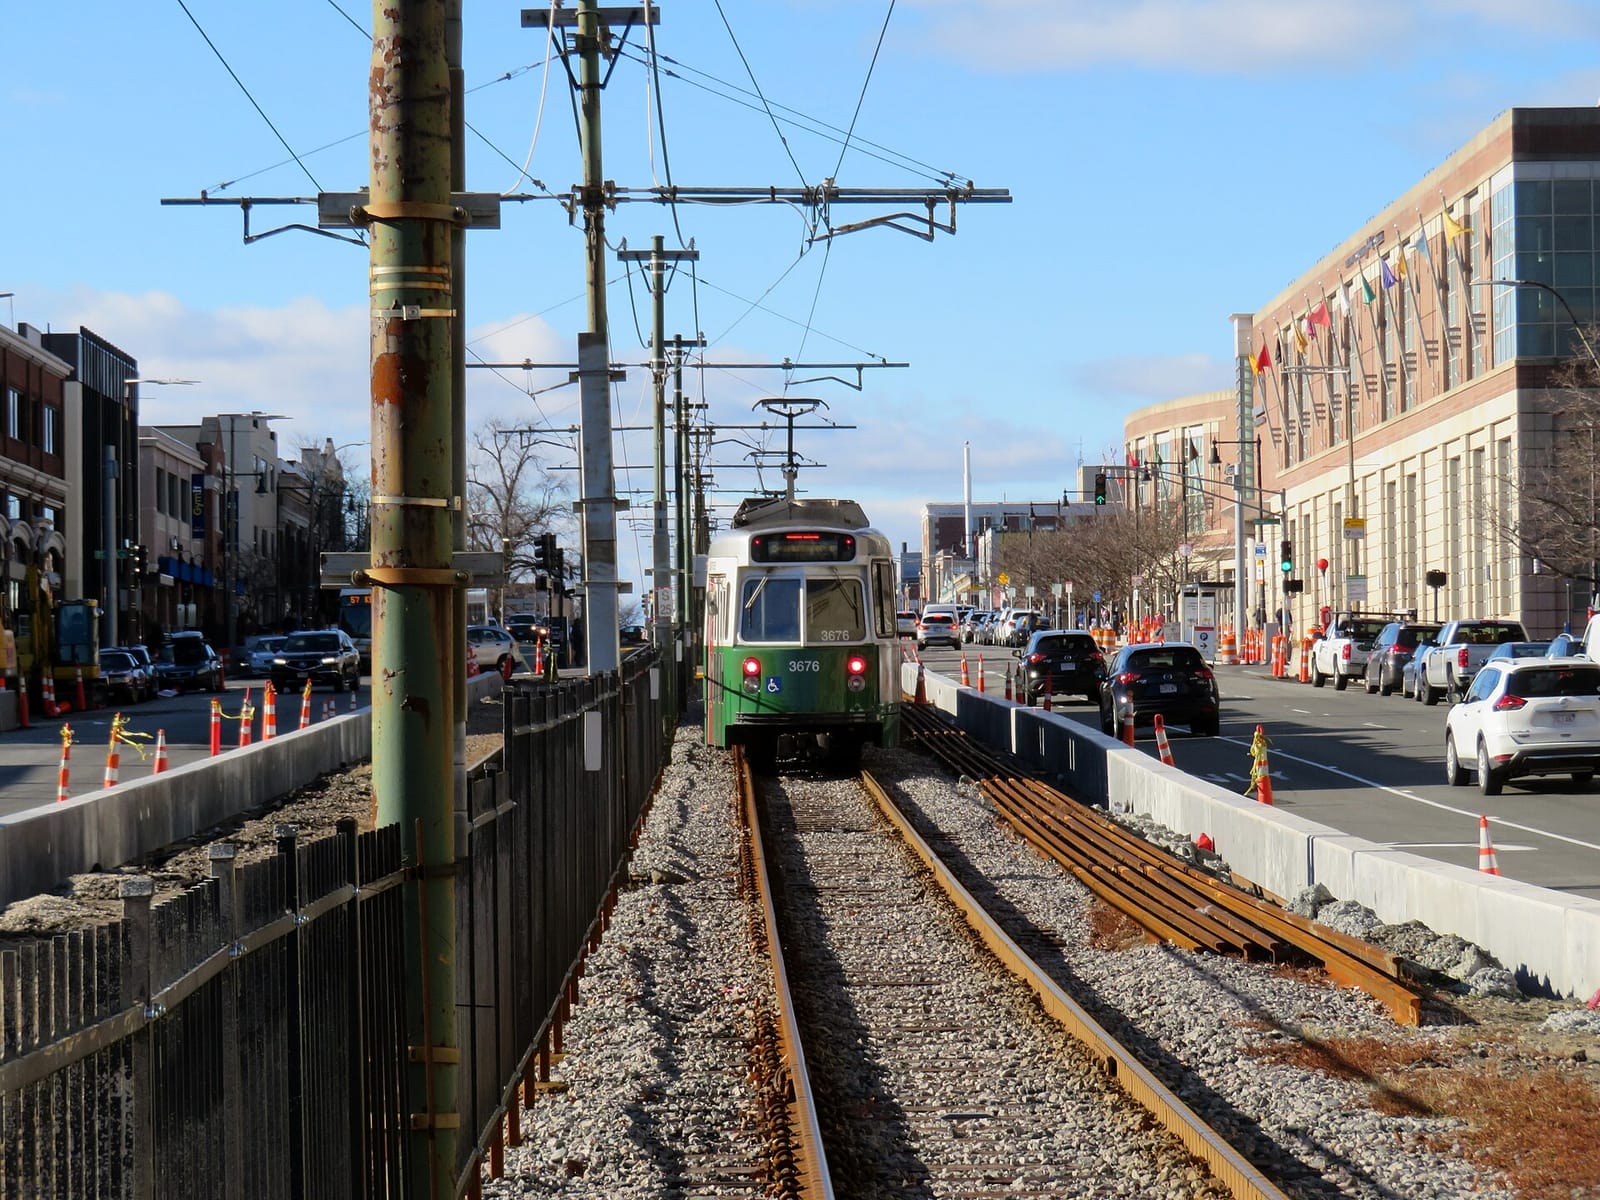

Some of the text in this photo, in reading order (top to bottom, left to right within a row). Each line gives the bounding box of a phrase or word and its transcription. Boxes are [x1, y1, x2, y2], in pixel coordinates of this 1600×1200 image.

[661, 590, 670, 601] S
[660, 604, 672, 615] 25
[821, 630, 850, 641] 3676
[789, 660, 820, 672] 3676
